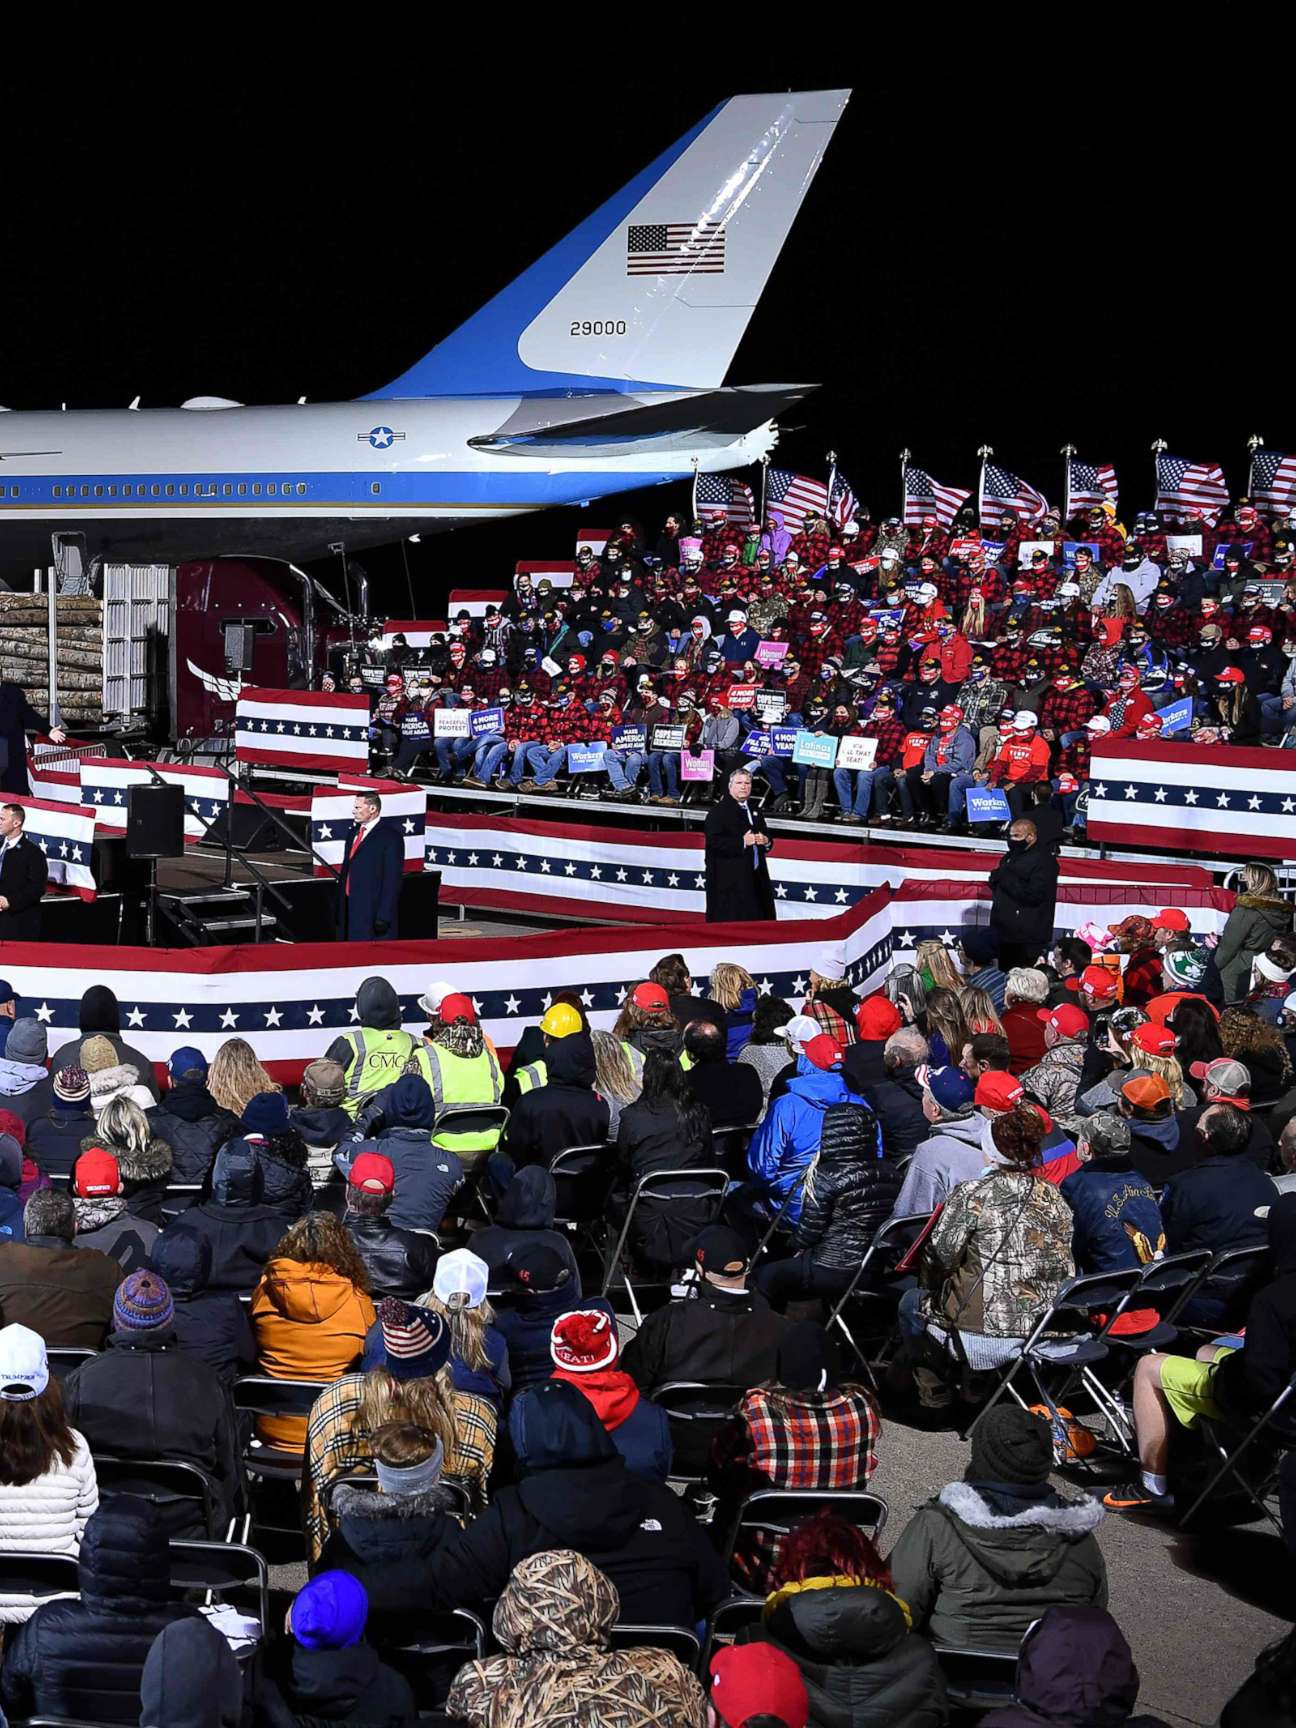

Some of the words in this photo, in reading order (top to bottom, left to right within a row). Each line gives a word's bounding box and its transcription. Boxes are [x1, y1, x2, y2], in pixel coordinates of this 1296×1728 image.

[570, 321, 626, 336] 29000
[616, 735, 644, 744] AMERICA
[801, 741, 831, 752] Latinos
[369, 1054, 407, 1068] CMC
